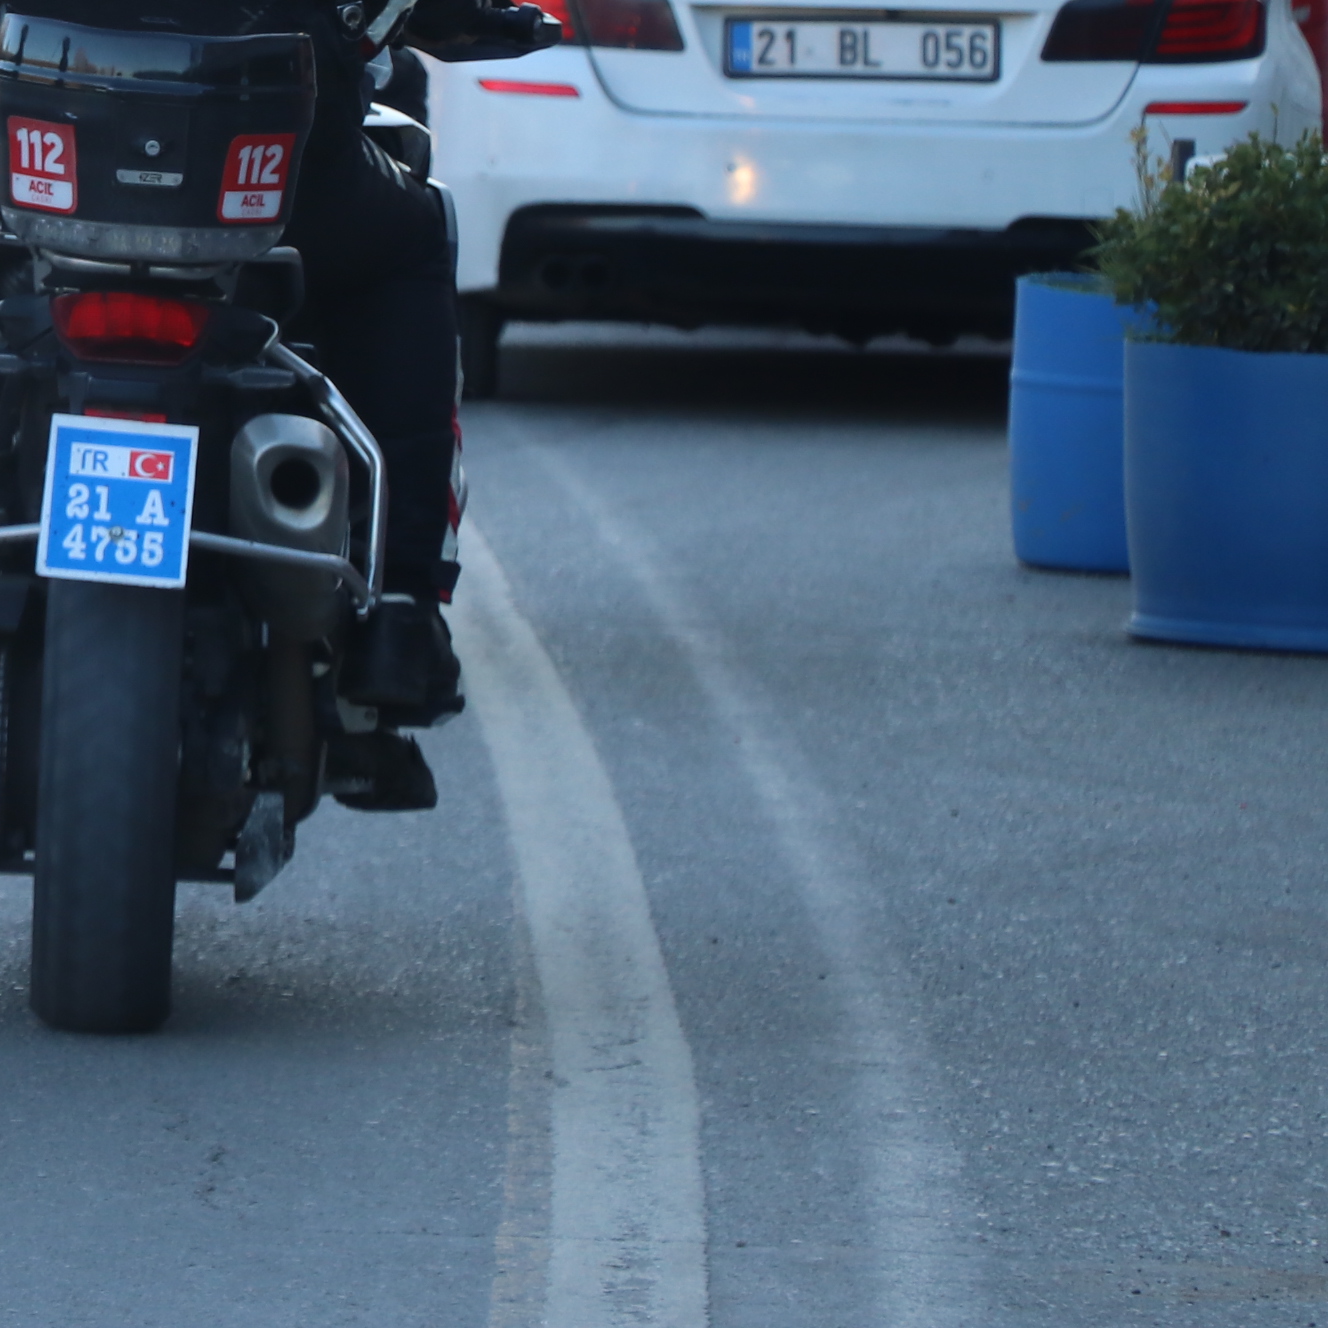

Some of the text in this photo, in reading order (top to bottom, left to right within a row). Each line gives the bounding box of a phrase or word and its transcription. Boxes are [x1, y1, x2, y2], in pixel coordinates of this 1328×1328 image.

[757, 28, 989, 70] 21 BL 056
[16, 127, 65, 175] 112
[237, 143, 284, 185] 112
[78, 448, 109, 472] TR
[66, 483, 170, 527] 21 A
